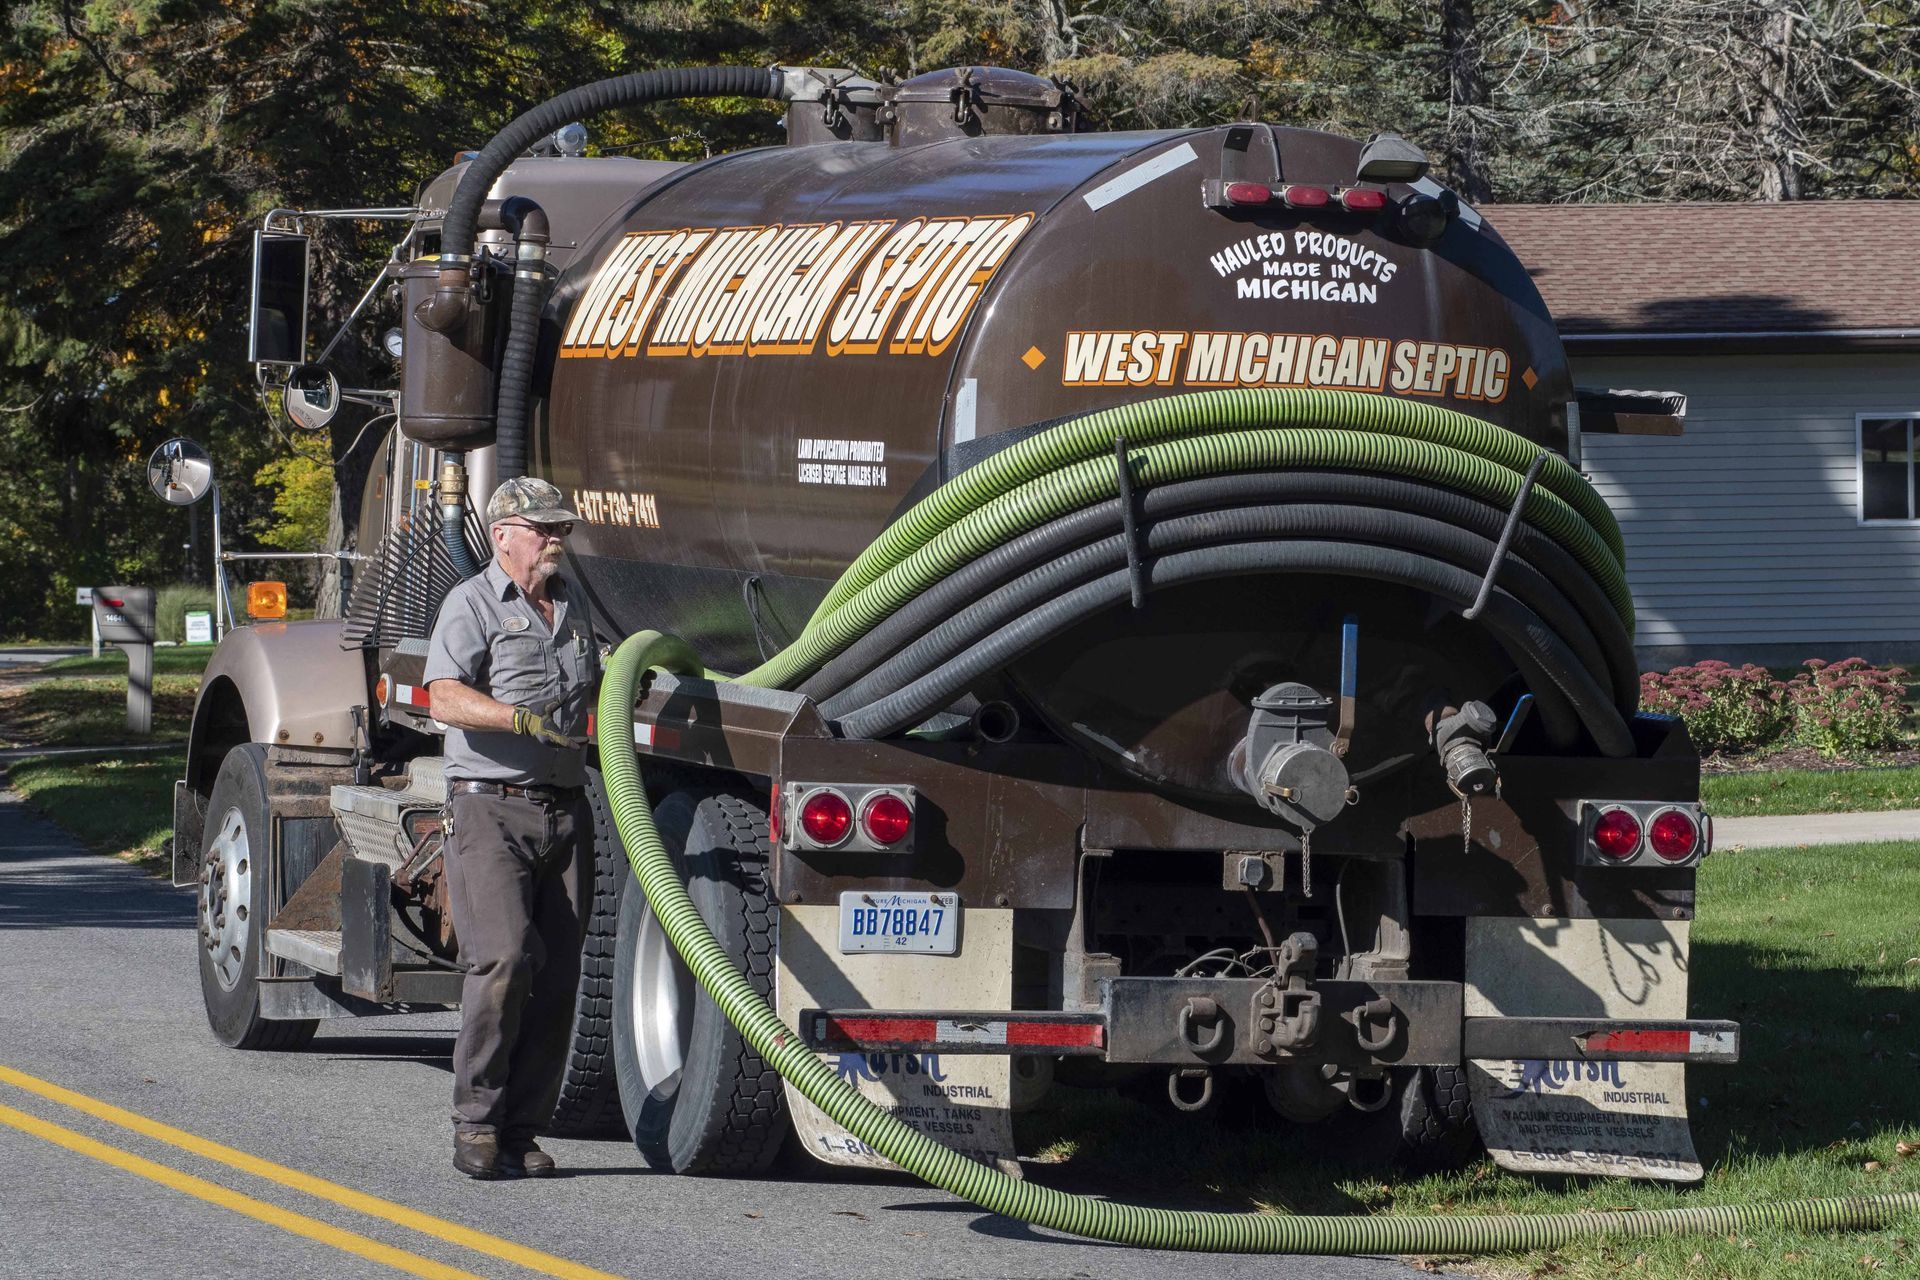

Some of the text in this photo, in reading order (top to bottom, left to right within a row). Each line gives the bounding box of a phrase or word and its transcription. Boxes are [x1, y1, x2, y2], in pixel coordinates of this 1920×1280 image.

[1210, 231, 1398, 283] HAULED PRODUCTS
[1262, 263, 1351, 279] MADE IN
[560, 211, 1035, 358] WEST MICHIGAN SEPTIC
[1237, 279, 1377, 304] MICHIGAN
[1062, 331, 1510, 402] WEST MICHIGAN SEPTIC
[798, 438, 885, 462] LAND APPLICATION PROHIBITED
[798, 463, 822, 483] LICENSED
[823, 464, 847, 485] SEPTAGE
[847, 465, 871, 486] HAULERS
[573, 489, 660, 528] 1-877-739-7411
[852, 908, 944, 936] BB78847
[895, 937, 907, 945] 42
[923, 1085, 992, 1099] INDUSTRIAL
[1604, 1091, 1669, 1104] INDUSTRIAL
[945, 1108, 981, 1120] TANKS
[1503, 1110, 1550, 1122] VACUUM
[1625, 1113, 1660, 1125] TANKS
[924, 1121, 974, 1134] VESSELS
[1518, 1124, 1655, 1138] AND PRESSURE VESSELS
